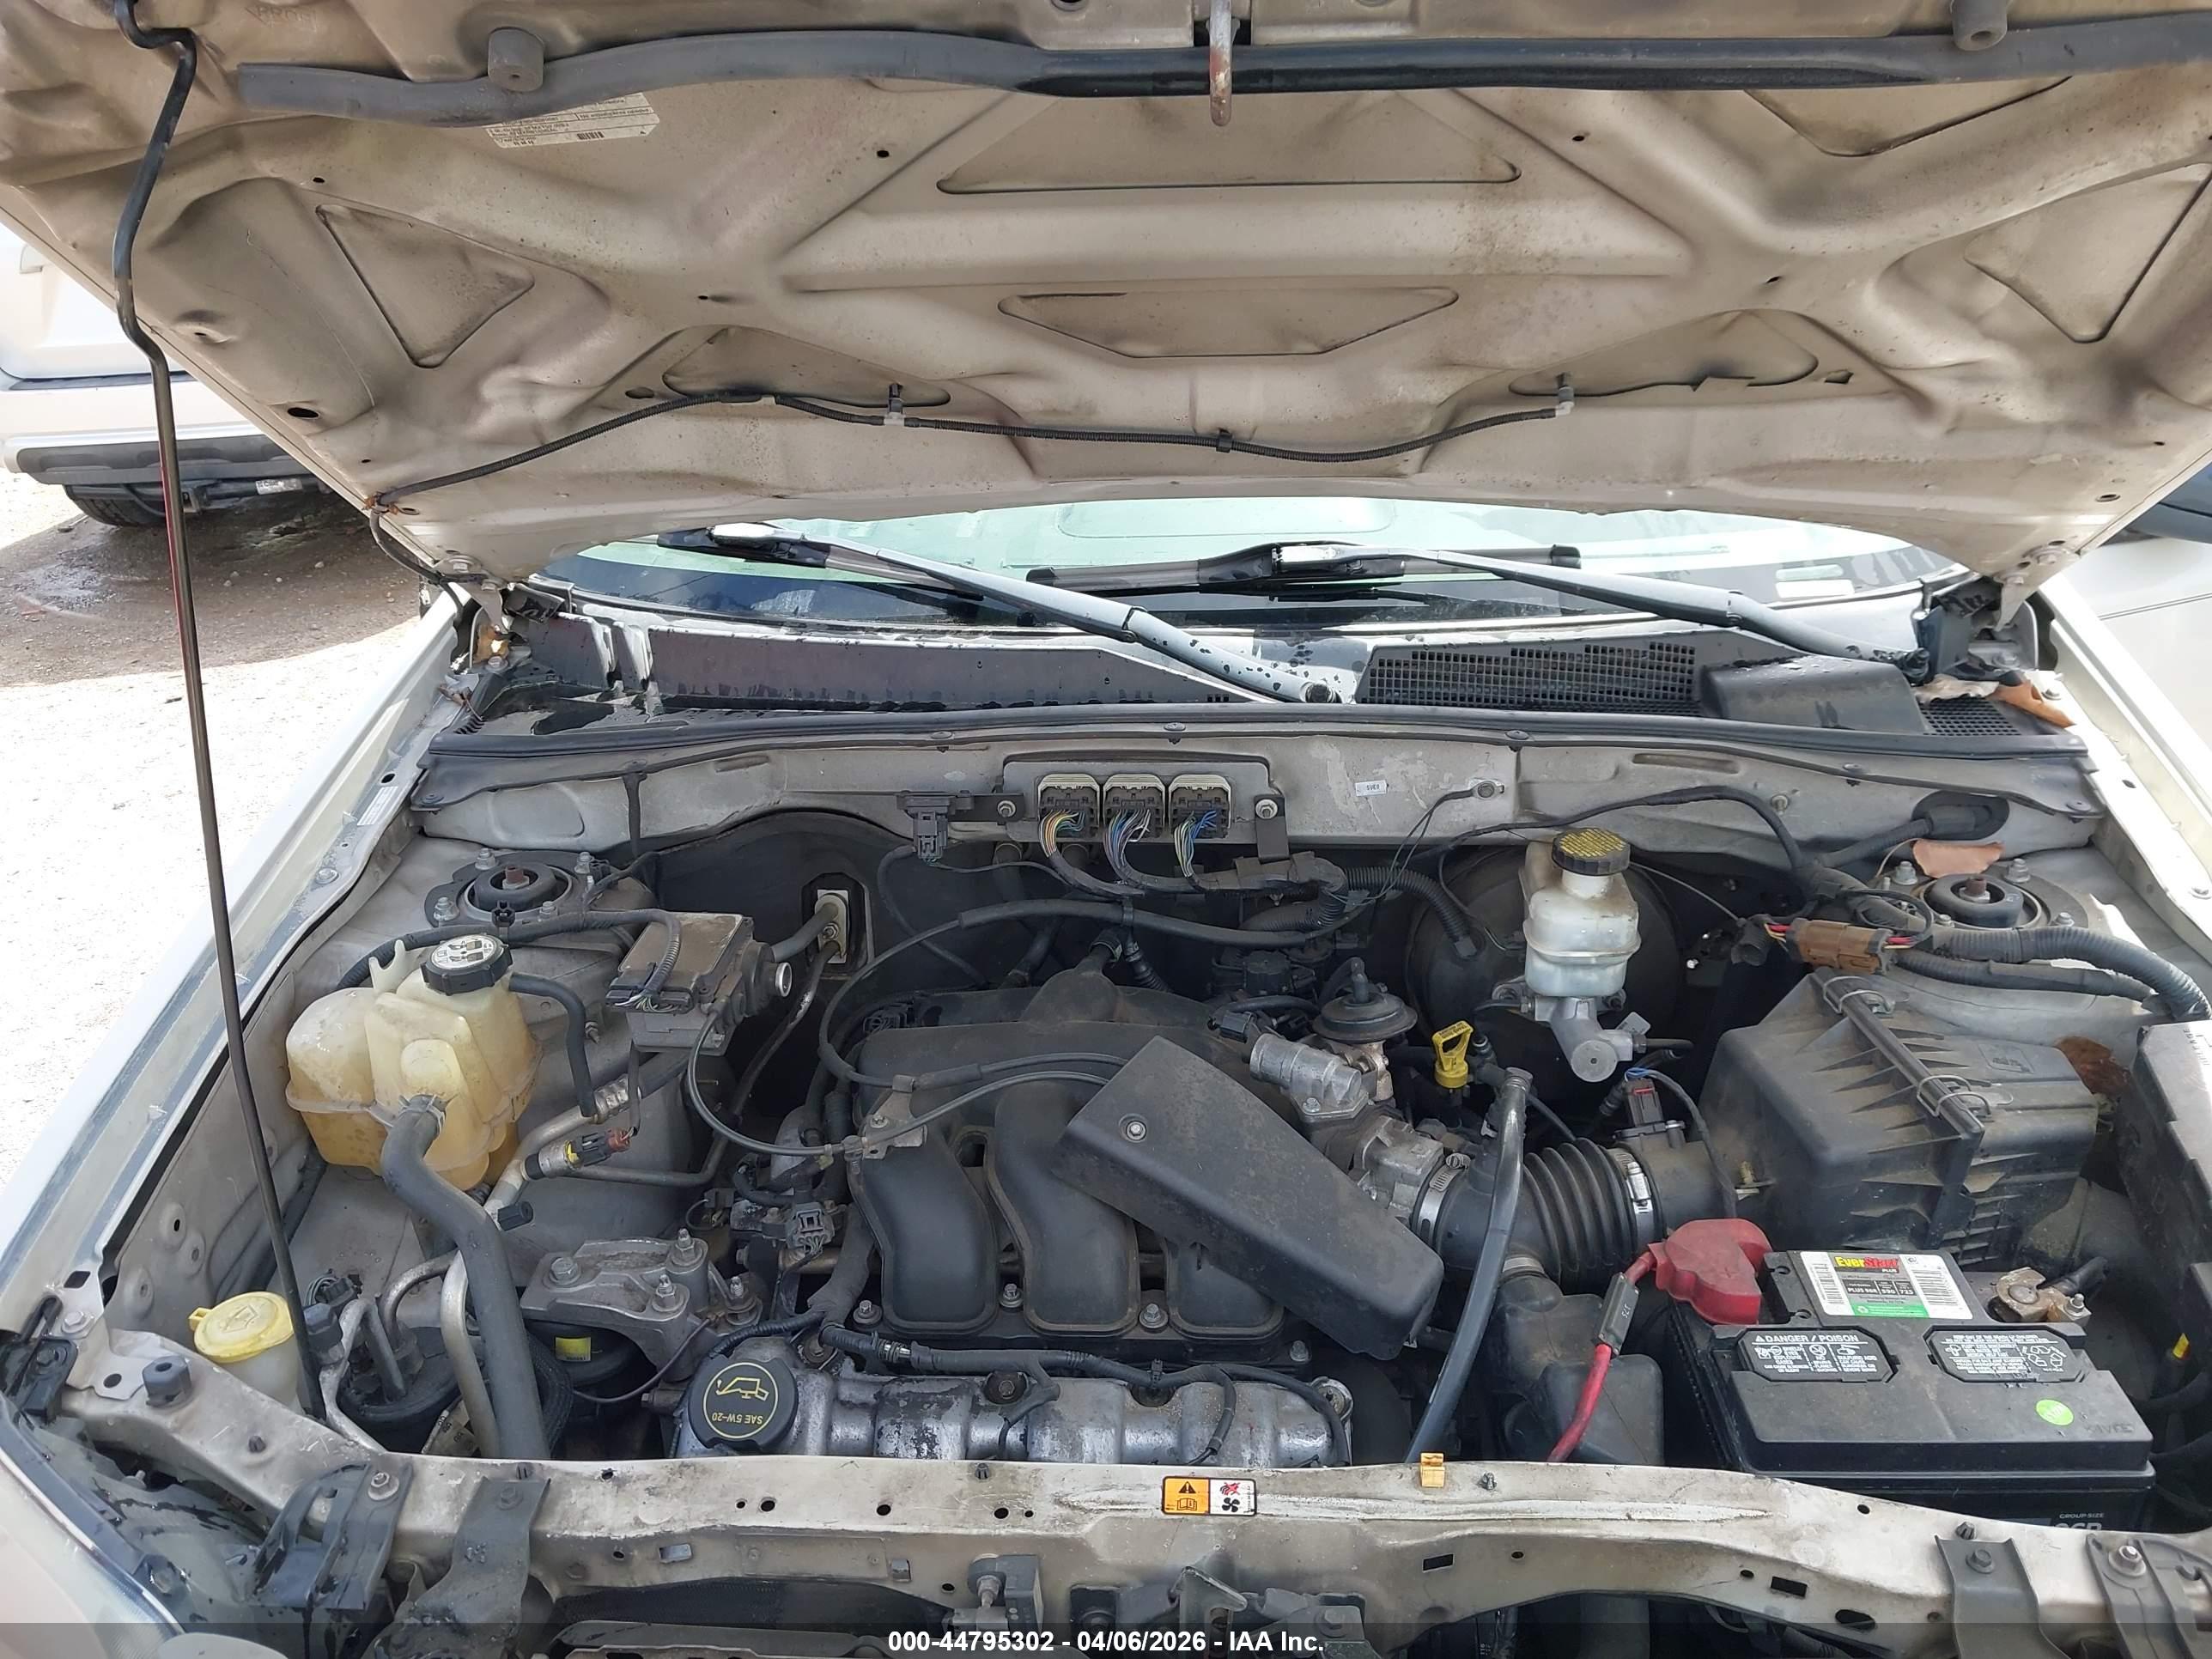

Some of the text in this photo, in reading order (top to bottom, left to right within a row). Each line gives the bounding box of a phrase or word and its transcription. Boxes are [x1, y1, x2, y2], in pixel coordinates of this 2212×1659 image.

[1834, 1256, 1898, 1267] EverStart
[711, 1412, 763, 1425] SAE 5W-20
